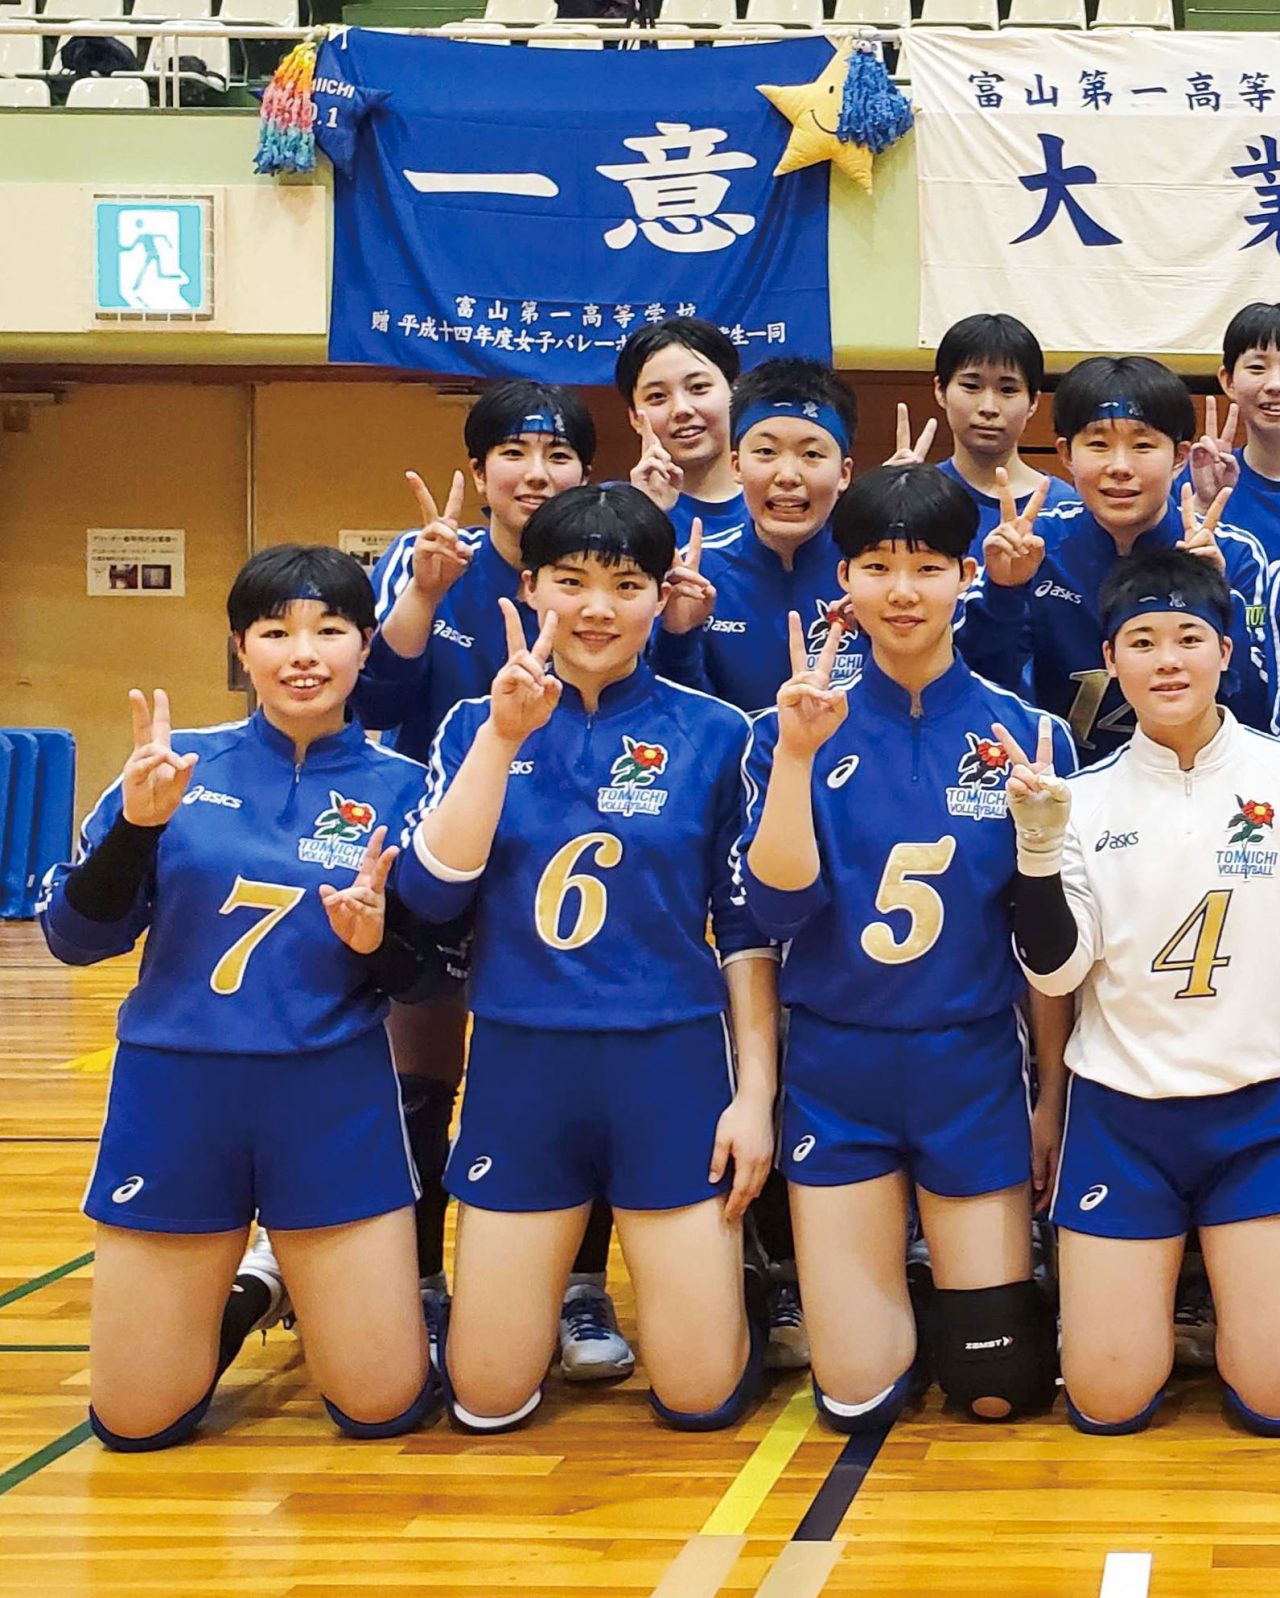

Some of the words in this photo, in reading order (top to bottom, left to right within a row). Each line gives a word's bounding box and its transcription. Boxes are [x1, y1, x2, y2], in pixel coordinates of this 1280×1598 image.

[403, 122, 759, 254] 一意
[371, 309, 390, 333] 贈
[456, 295, 697, 330] 富山第一高等学校
[1049, 585, 1083, 604] asics
[440, 626, 476, 648] asics
[711, 619, 747, 634] asics
[509, 761, 535, 775] sics
[200, 790, 243, 809] asics
[1109, 831, 1139, 850] asics
[535, 832, 623, 950] 6
[860, 835, 957, 965] 5
[209, 874, 306, 996] 7
[1151, 889, 1234, 1000] 4
